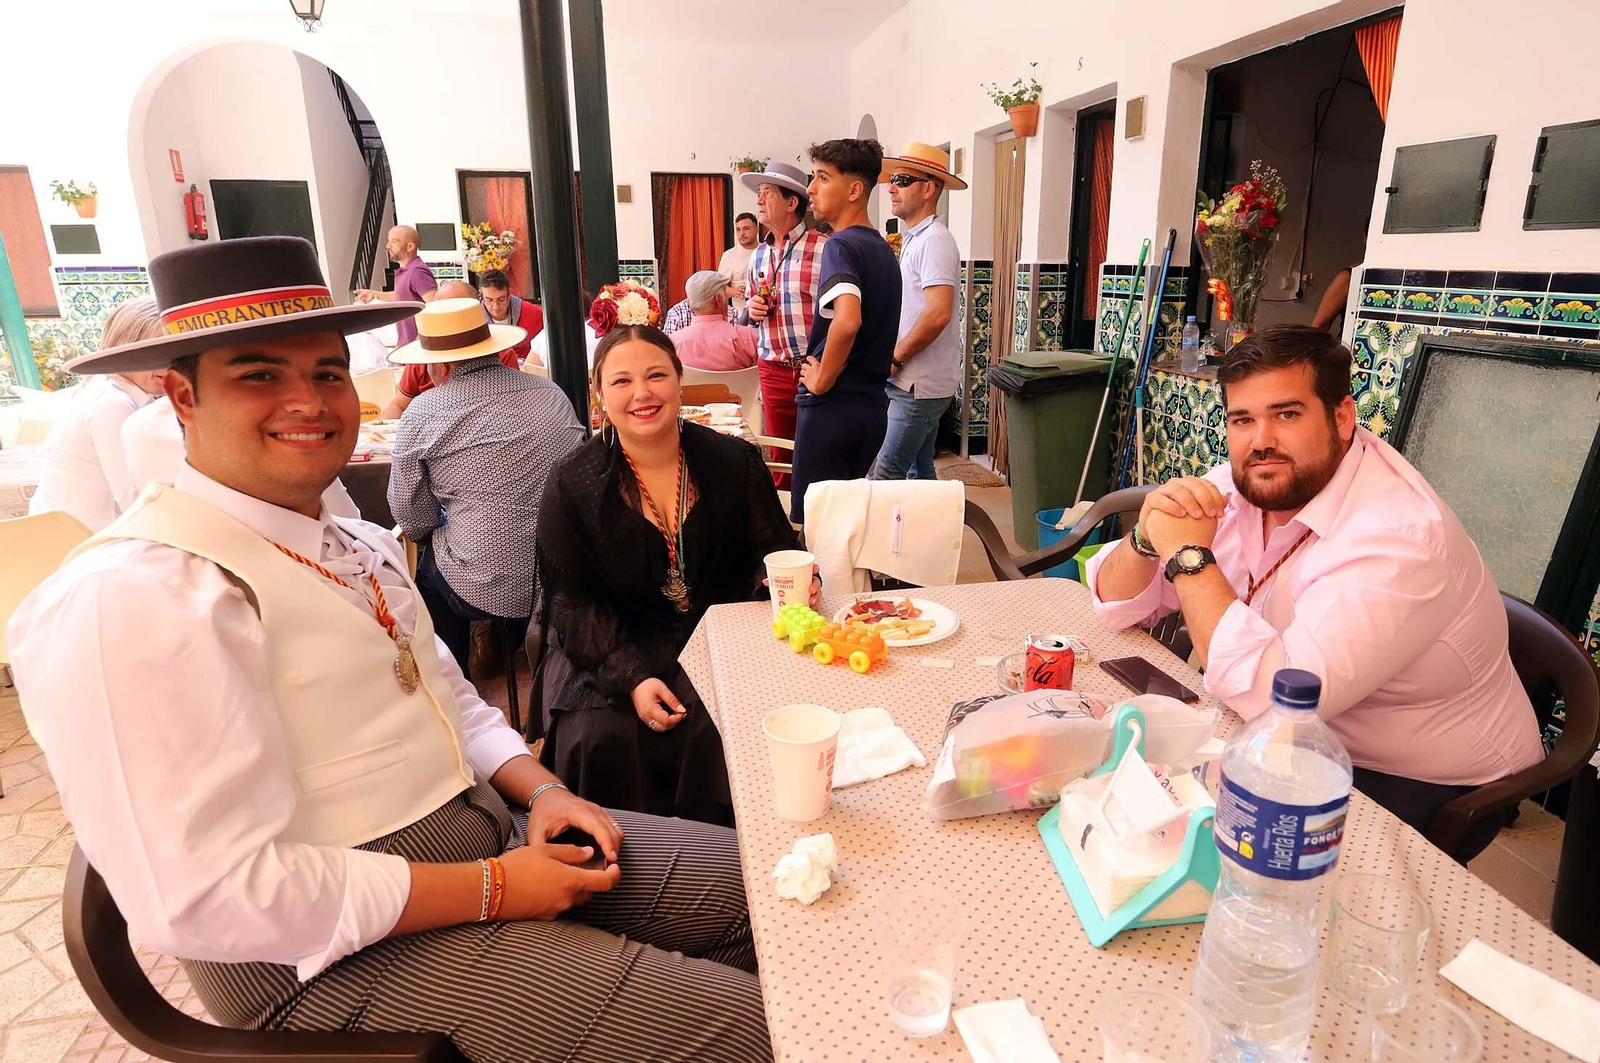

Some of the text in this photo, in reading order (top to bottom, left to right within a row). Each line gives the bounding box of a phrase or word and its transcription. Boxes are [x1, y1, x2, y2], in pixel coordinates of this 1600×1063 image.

[691, 152, 696, 160] 3
[177, 297, 307, 334] EMIGRANTES
[1267, 836, 1295, 870] Huerta
